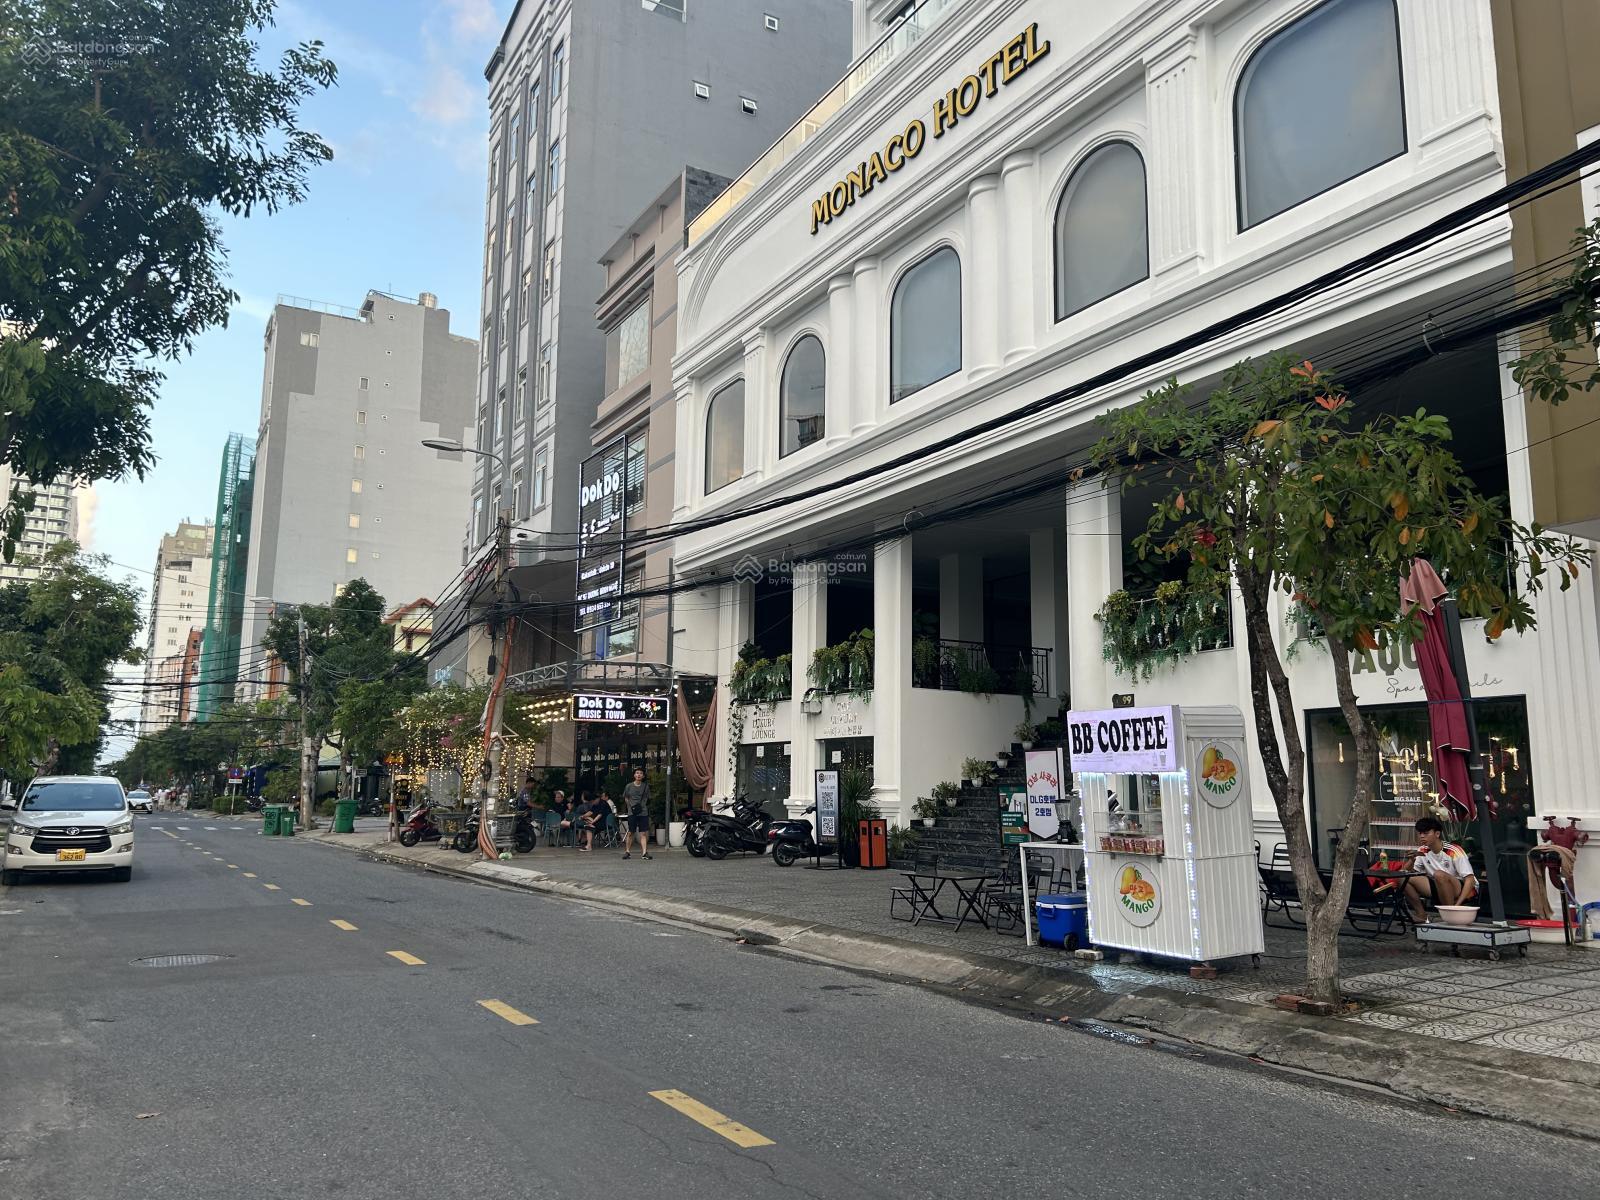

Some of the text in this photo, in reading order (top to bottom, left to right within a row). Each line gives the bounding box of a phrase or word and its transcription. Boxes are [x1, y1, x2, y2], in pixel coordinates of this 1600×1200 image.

[810, 22, 1050, 235] MONACO HOTEL
[1387, 678, 1415, 698] Spa
[579, 697, 622, 709] Dok Do
[579, 709, 626, 719] MUSIC TOWN
[751, 729, 776, 740] LOUNGE
[1070, 715, 1168, 755] BB COFFEE
[1204, 776, 1236, 794] MANGO
[1121, 894, 1155, 914] MANGO
